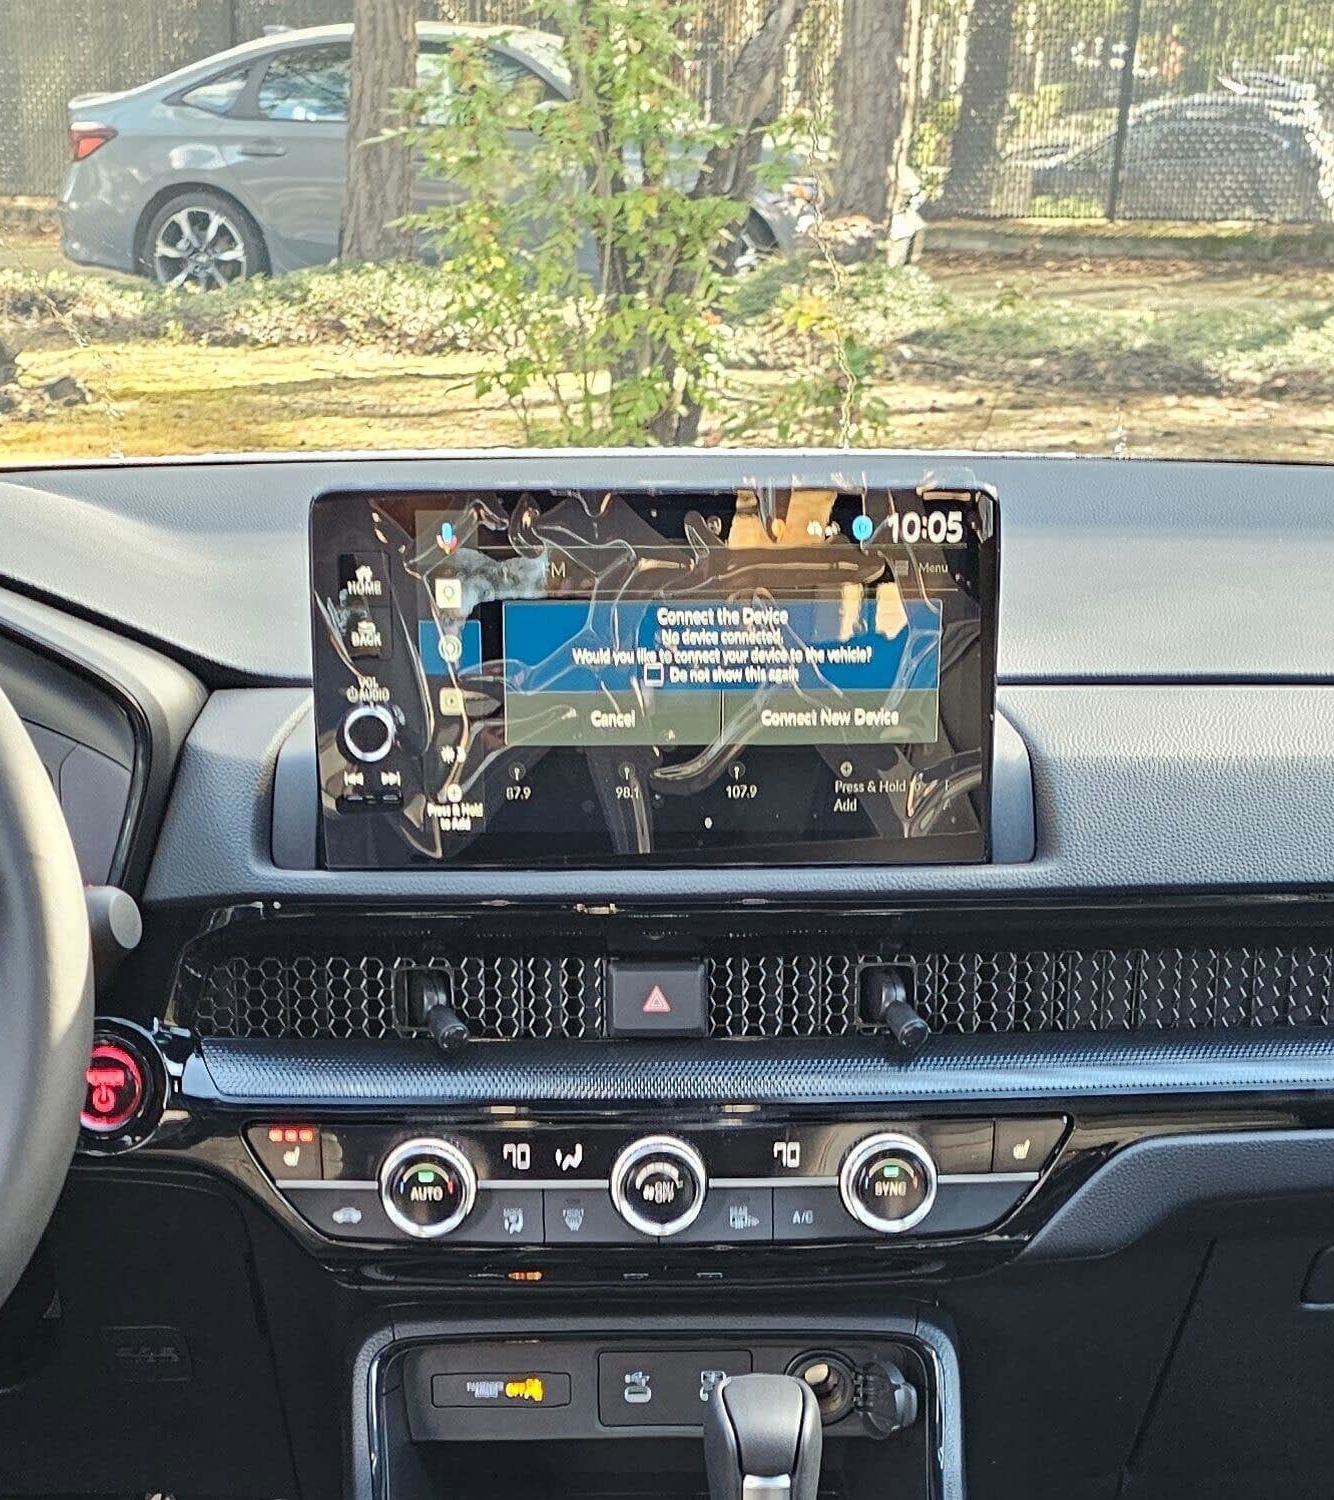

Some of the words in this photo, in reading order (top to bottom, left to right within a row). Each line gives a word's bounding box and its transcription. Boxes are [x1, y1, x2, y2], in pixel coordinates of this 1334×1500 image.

[888, 512, 963, 544] 10:05
[920, 562, 948, 574] Menu
[347, 581, 381, 595] HOME
[657, 607, 714, 625] Connect
[718, 607, 740, 625] the
[743, 607, 788, 625] Device
[351, 633, 381, 647] BACK
[662, 630, 680, 645] No
[682, 629, 718, 645] device
[571, 648, 610, 664] Would
[613, 651, 634, 667] you
[637, 648, 657, 664] like
[659, 649, 673, 664] to
[675, 649, 721, 664] connect
[722, 649, 749, 666] your
[751, 647, 788, 663] device
[790, 648, 804, 663] to
[806, 647, 825, 663] the
[828, 646, 872, 663] vehicle?
[670, 667, 687, 682] Do
[690, 667, 710, 682] not
[713, 667, 742, 682] show
[745, 667, 766, 683] this
[768, 667, 799, 684] again
[591, 710, 635, 727] Cancel
[761, 709, 816, 726] Connect
[821, 708, 851, 726] New
[854, 708, 899, 726] Device
[506, 787, 531, 800] 87.9
[616, 787, 639, 799] 98.1
[725, 785, 757, 798] 107.9
[835, 781, 864, 794] Press
[867, 781, 876, 793] &
[879, 780, 905, 793] Hold
[834, 799, 857, 812] Add
[503, 1143, 531, 1170] 70
[773, 1141, 800, 1168] 70
[410, 1186, 443, 1201] AUTO
[875, 1181, 906, 1196] SYNC
